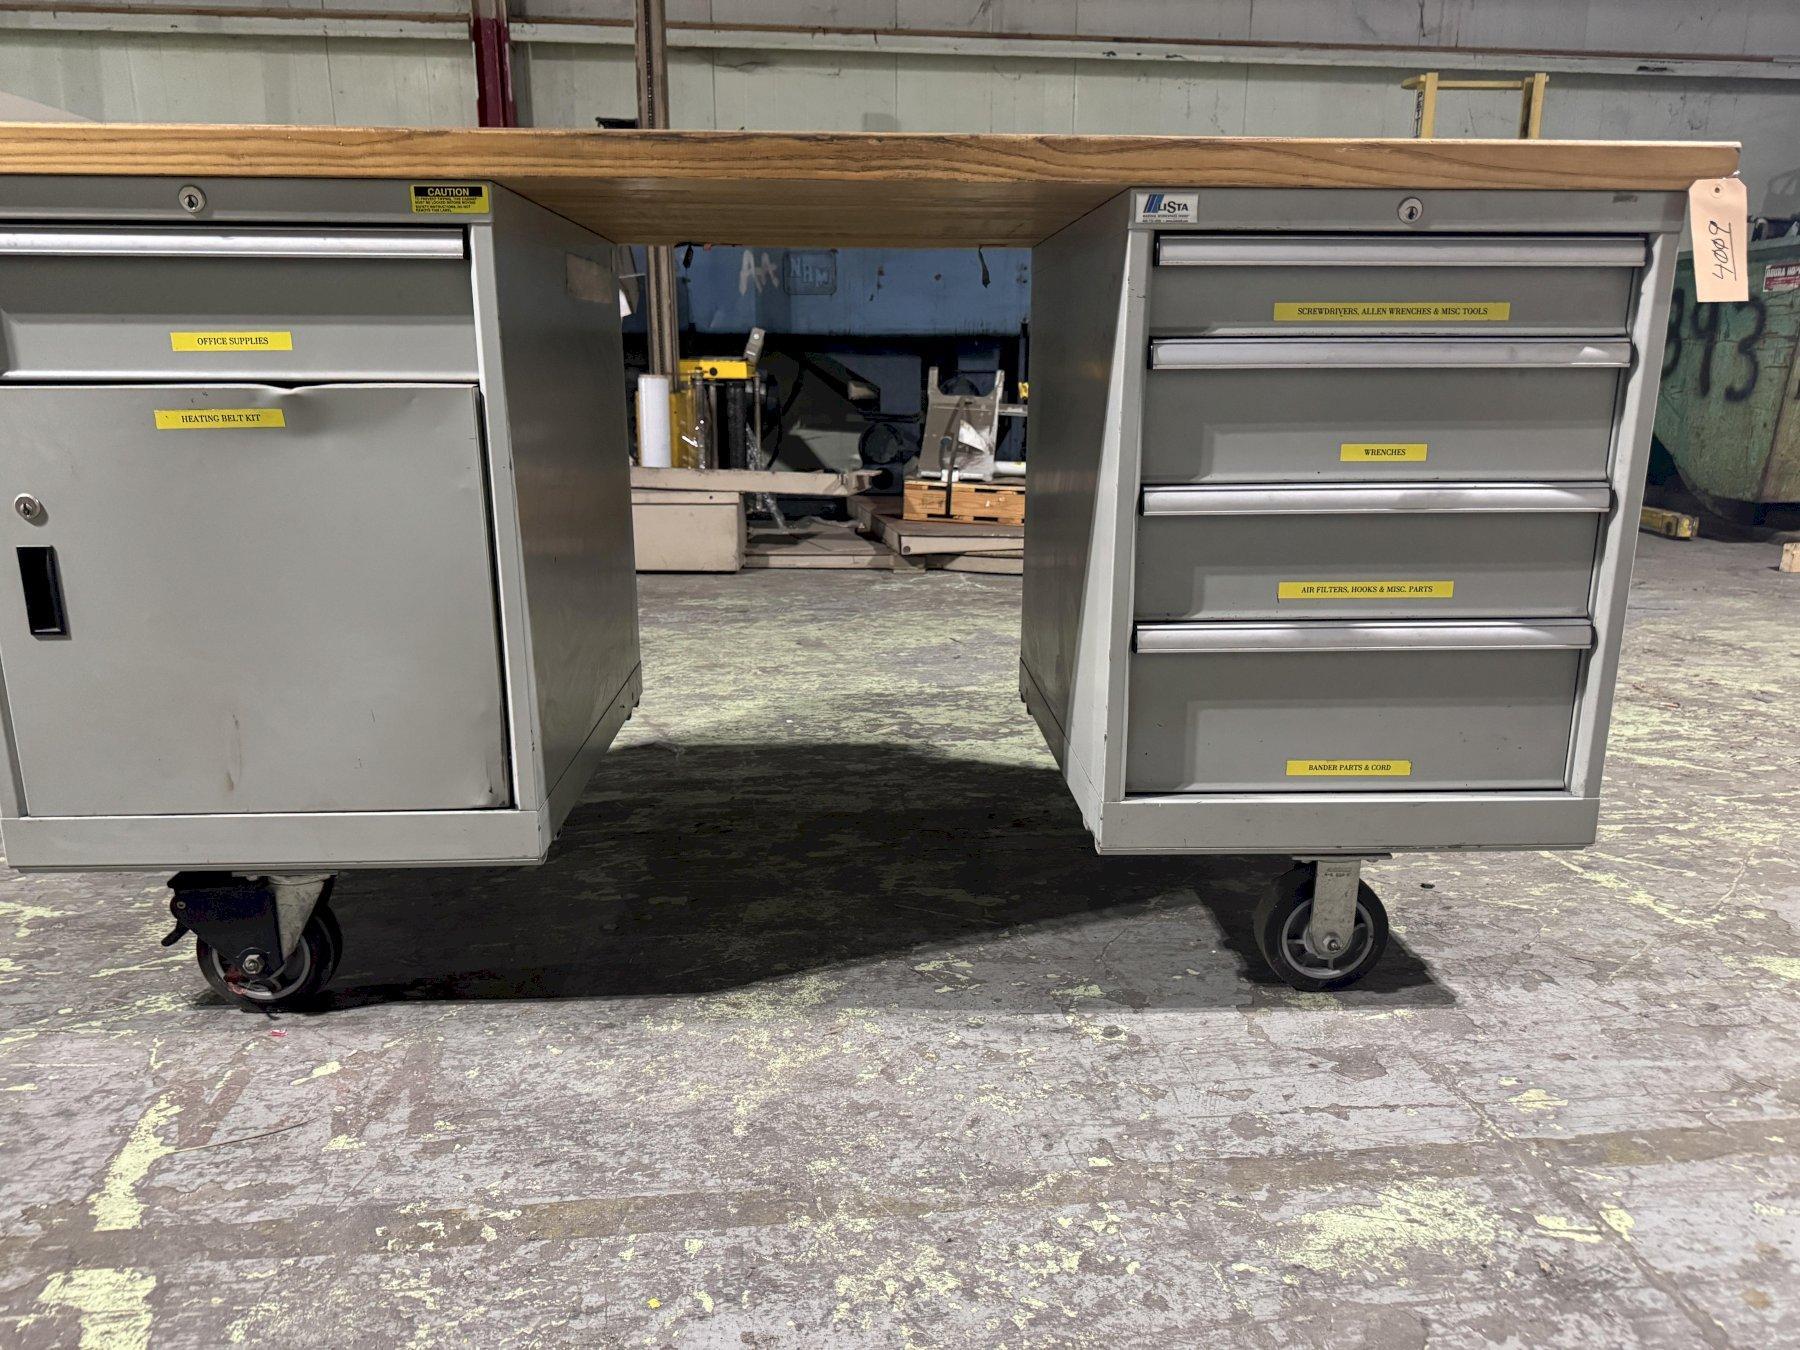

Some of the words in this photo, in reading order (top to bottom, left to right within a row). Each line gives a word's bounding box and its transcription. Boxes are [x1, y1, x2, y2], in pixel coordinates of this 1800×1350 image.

[427, 187, 470, 196] CAUTION
[1158, 200, 1189, 214] LISTA
[1708, 220, 1734, 280] 4009
[1297, 307, 1360, 316] SCREWDRIVERS,
[1361, 307, 1387, 315] ALLEN
[1388, 307, 1432, 315] WRENCHES
[1433, 307, 1440, 315] &
[1441, 307, 1460, 315] MISC
[1463, 307, 1488, 315] TOOLS
[196, 337, 227, 346] OFFICE
[229, 336, 269, 345] SUPPLIES
[181, 414, 220, 423] HEATING
[221, 413, 244, 422] BELT
[245, 413, 261, 422] KIT
[1364, 448, 1406, 456] WRENCHES
[1301, 586, 1315, 594] AIR
[1316, 586, 1350, 594] FILTERS,
[1351, 585, 1378, 593] HOOKS
[1378, 585, 1385, 593] &
[1386, 585, 1407, 593] MISC.
[1408, 585, 1434, 593] PARTS
